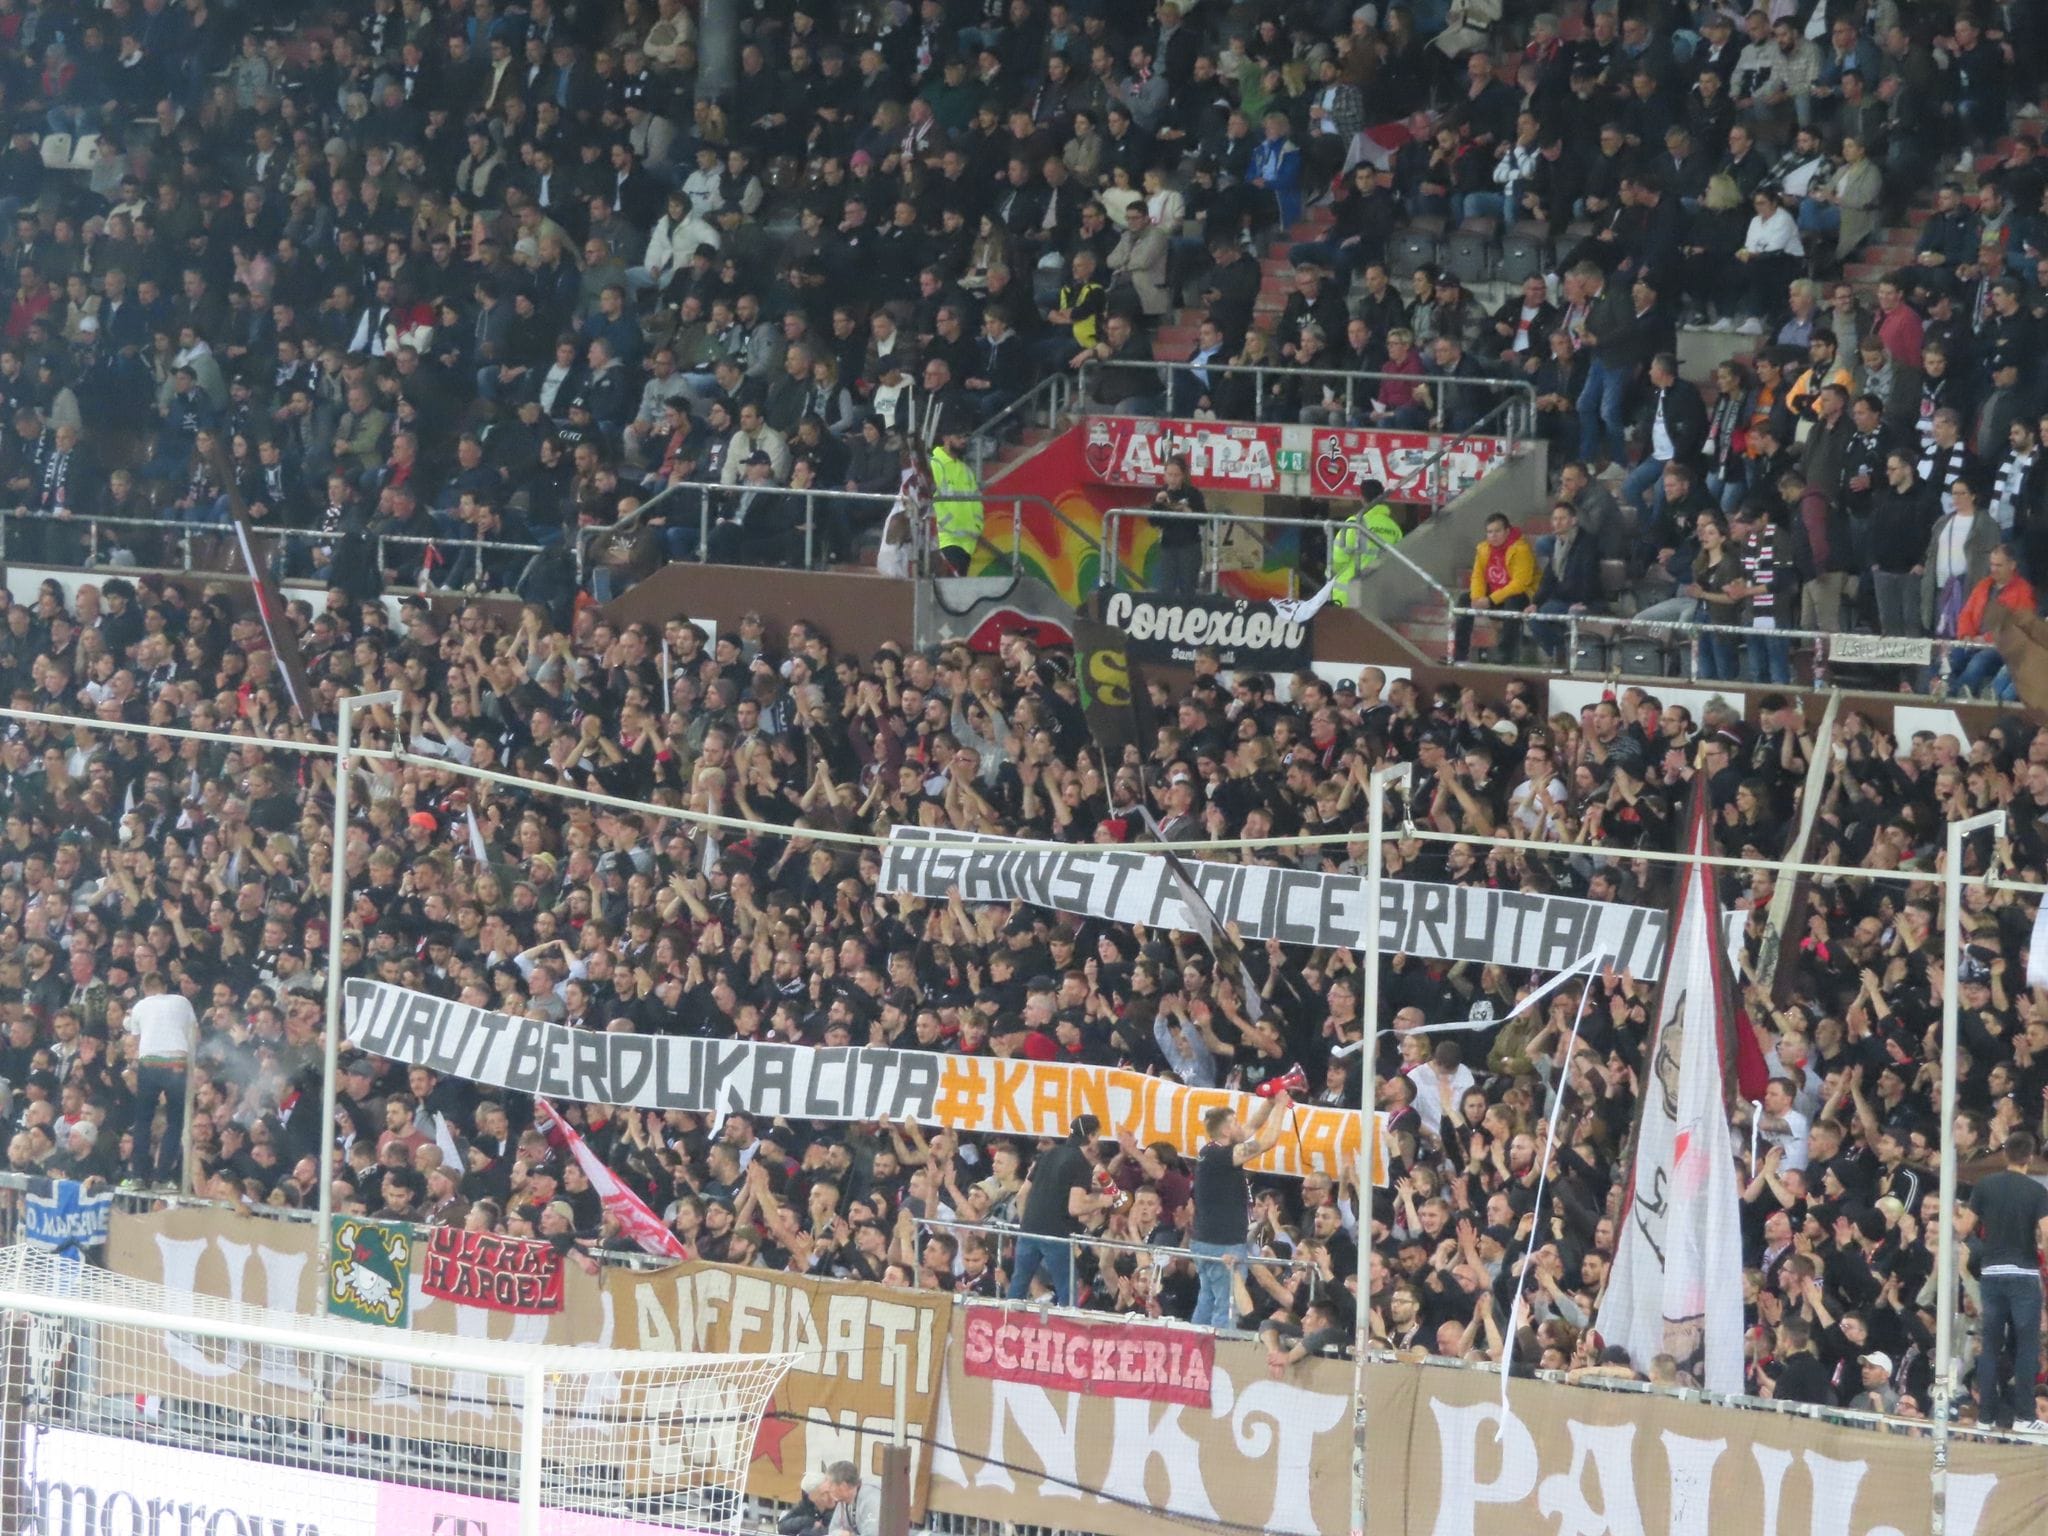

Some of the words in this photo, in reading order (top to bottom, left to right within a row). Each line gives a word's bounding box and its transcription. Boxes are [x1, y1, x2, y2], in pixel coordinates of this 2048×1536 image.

[1353, 446, 1504, 492] ASTR
[1106, 592, 1305, 649] Conexion
[887, 828, 1147, 918] AGAINST
[1149, 858, 1361, 949] POLICE
[1378, 870, 1733, 981] BRUTALIT
[346, 980, 508, 1080] TURUT
[425, 1251, 558, 1309] HAPOEL
[432, 1224, 560, 1274] ULTRAS
[634, 1268, 935, 1394] DIFFIDATI
[965, 1318, 1210, 1392] SCHICKERIA
[931, 1333, 1348, 1536] NKT
